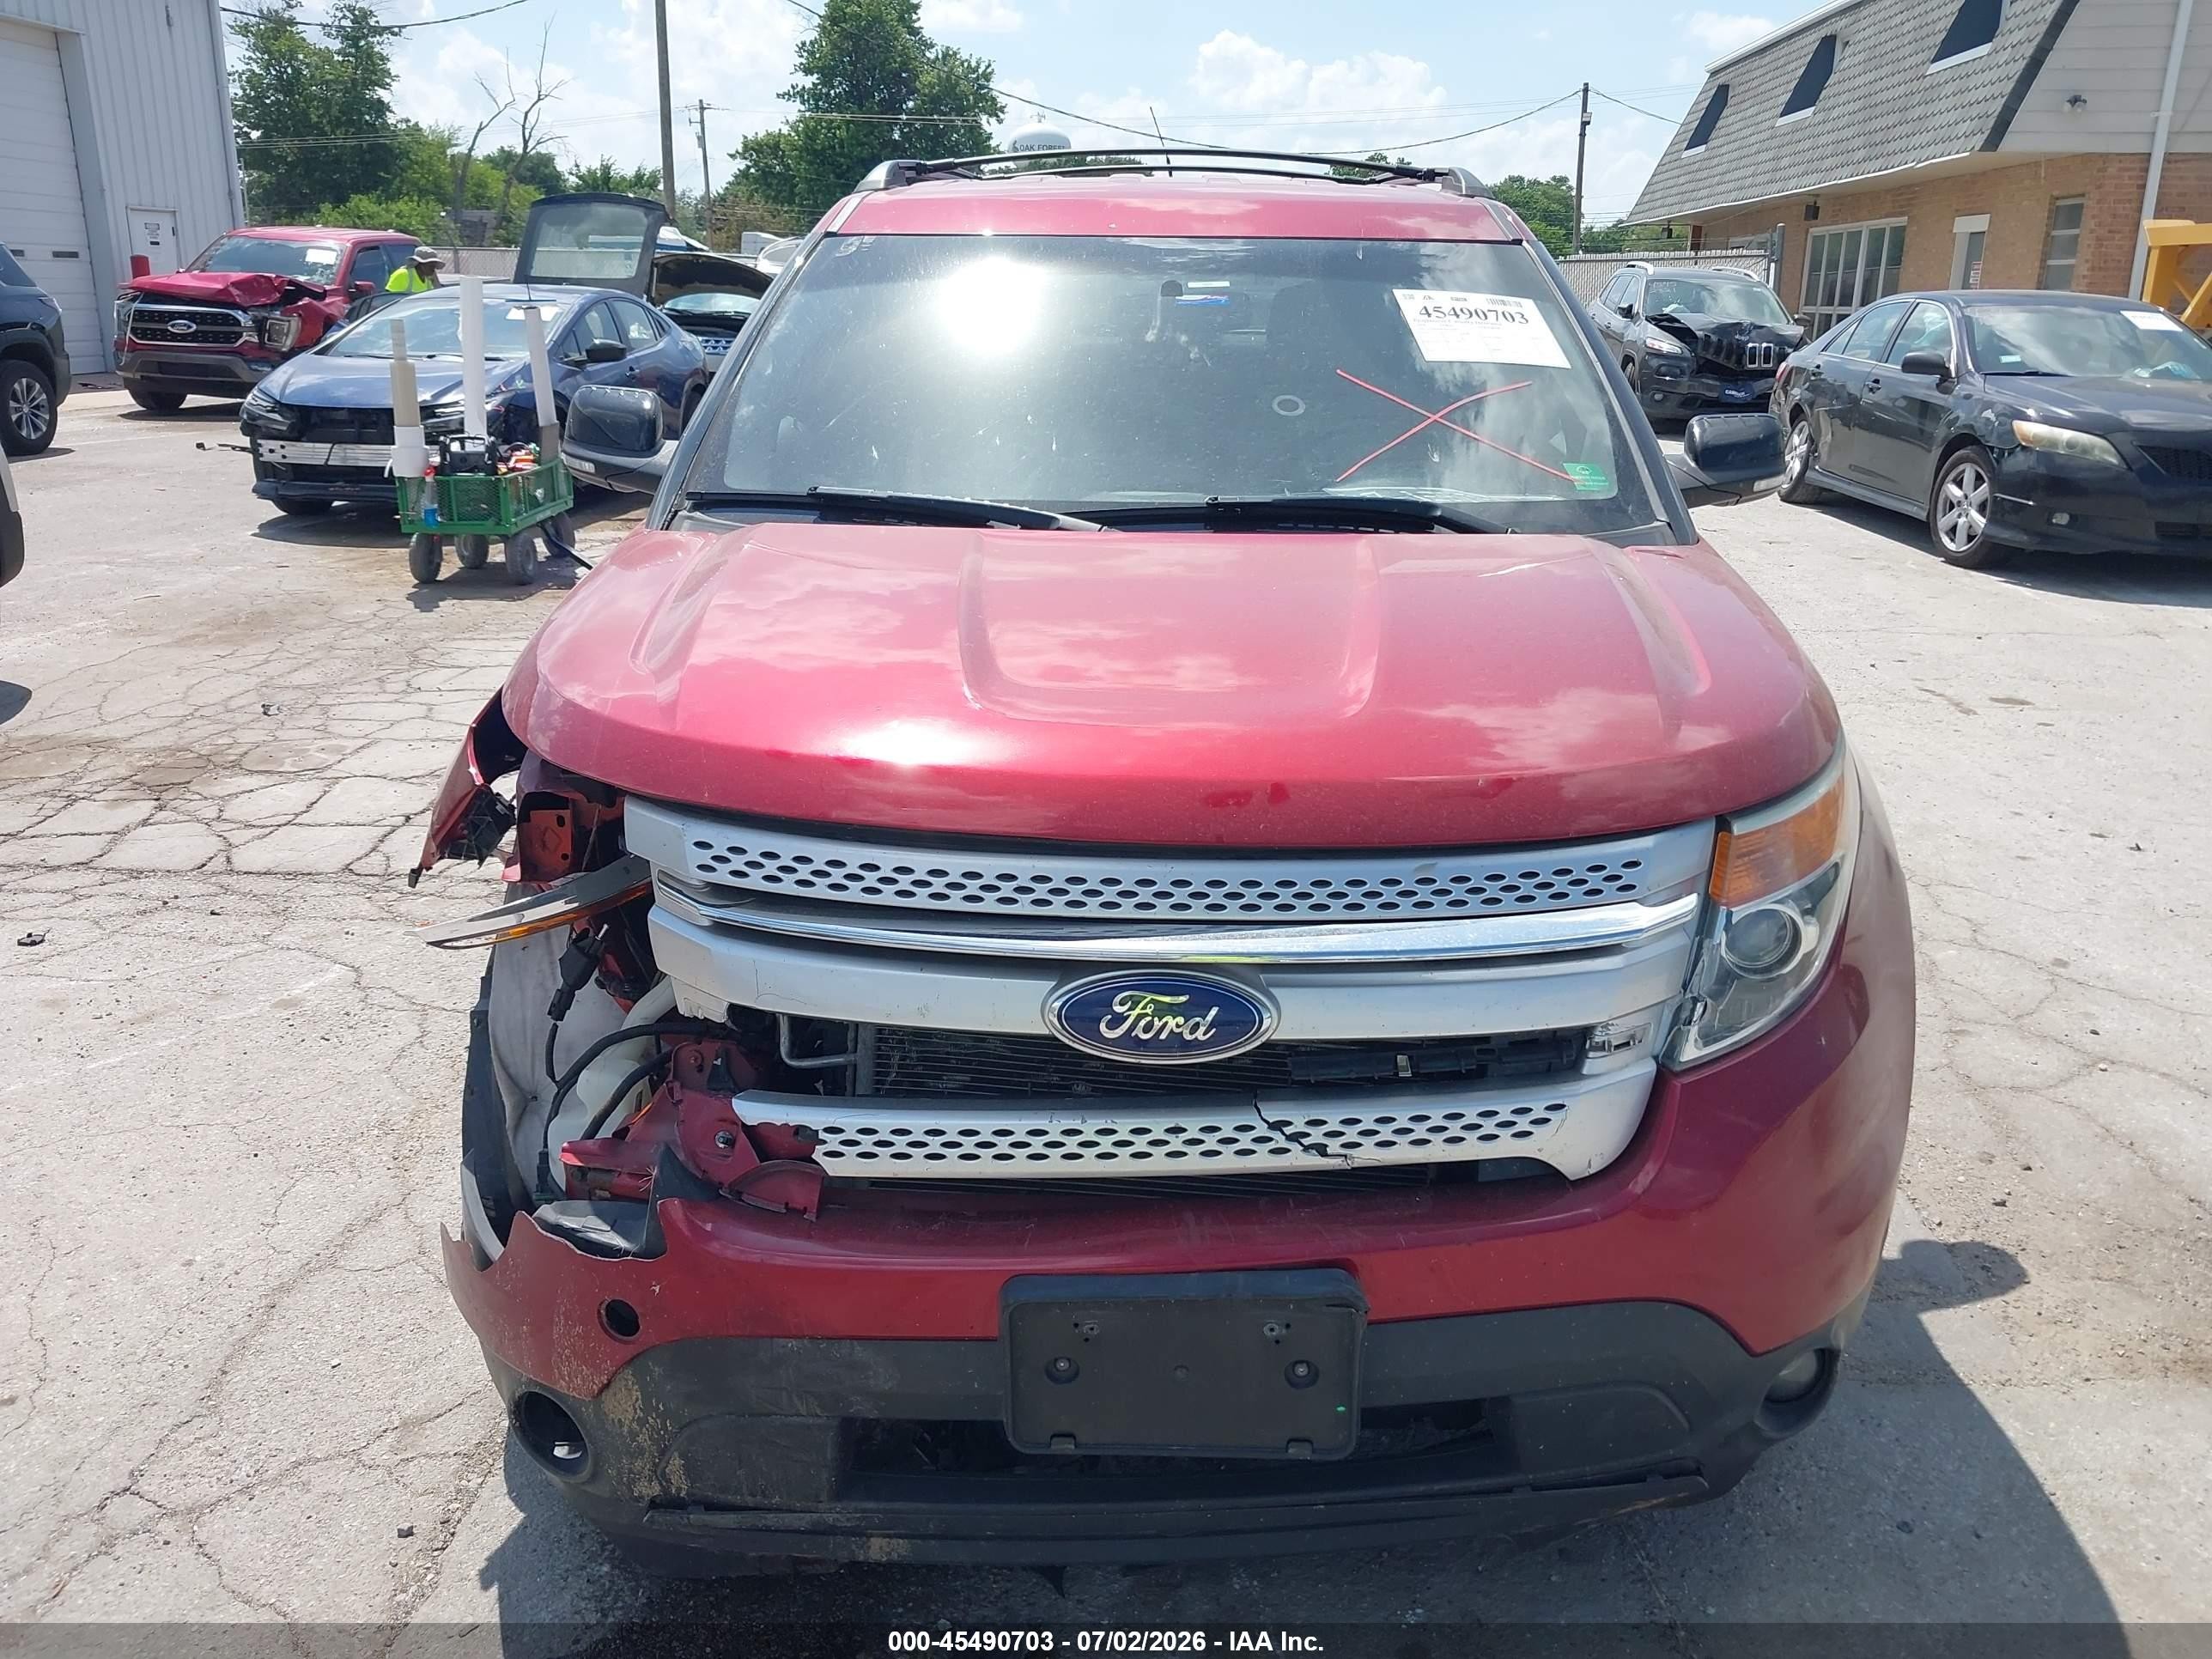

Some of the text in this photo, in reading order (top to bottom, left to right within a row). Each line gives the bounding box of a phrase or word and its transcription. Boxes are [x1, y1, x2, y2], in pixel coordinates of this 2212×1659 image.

[1019, 143, 1036, 152] OAK
[1419, 305, 1529, 325] 45490703
[1099, 990, 1220, 1041] Ford
